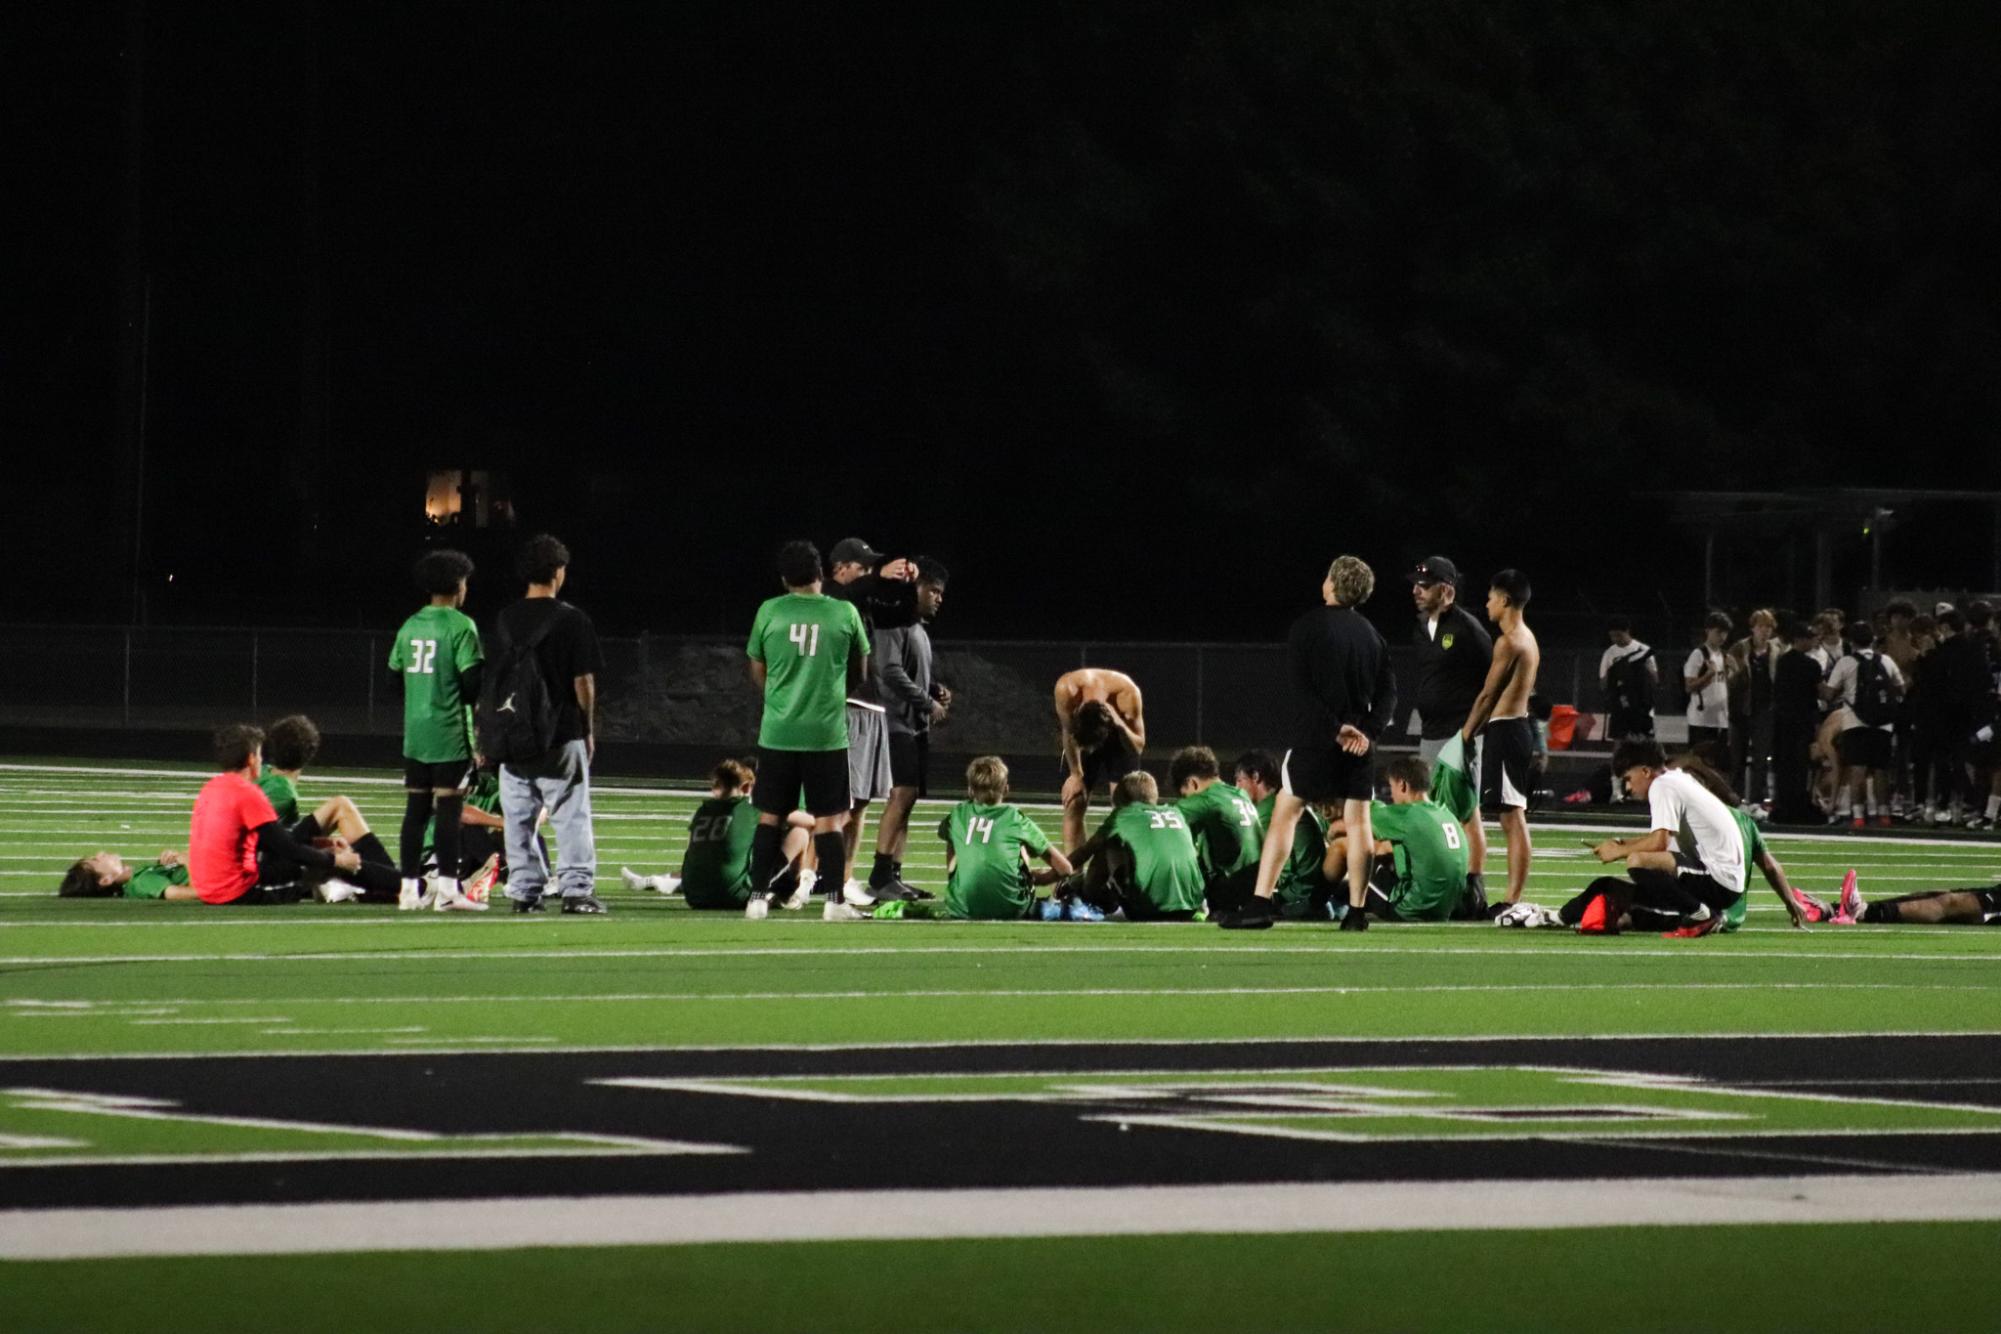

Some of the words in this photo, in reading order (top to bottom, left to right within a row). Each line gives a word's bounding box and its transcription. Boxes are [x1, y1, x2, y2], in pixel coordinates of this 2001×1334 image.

[790, 624, 819, 656] 41
[407, 640, 437, 673] 32
[693, 816, 733, 842] 20
[966, 817, 994, 845] 14
[1144, 810, 1183, 829] 35
[1442, 823, 1461, 849] 8
